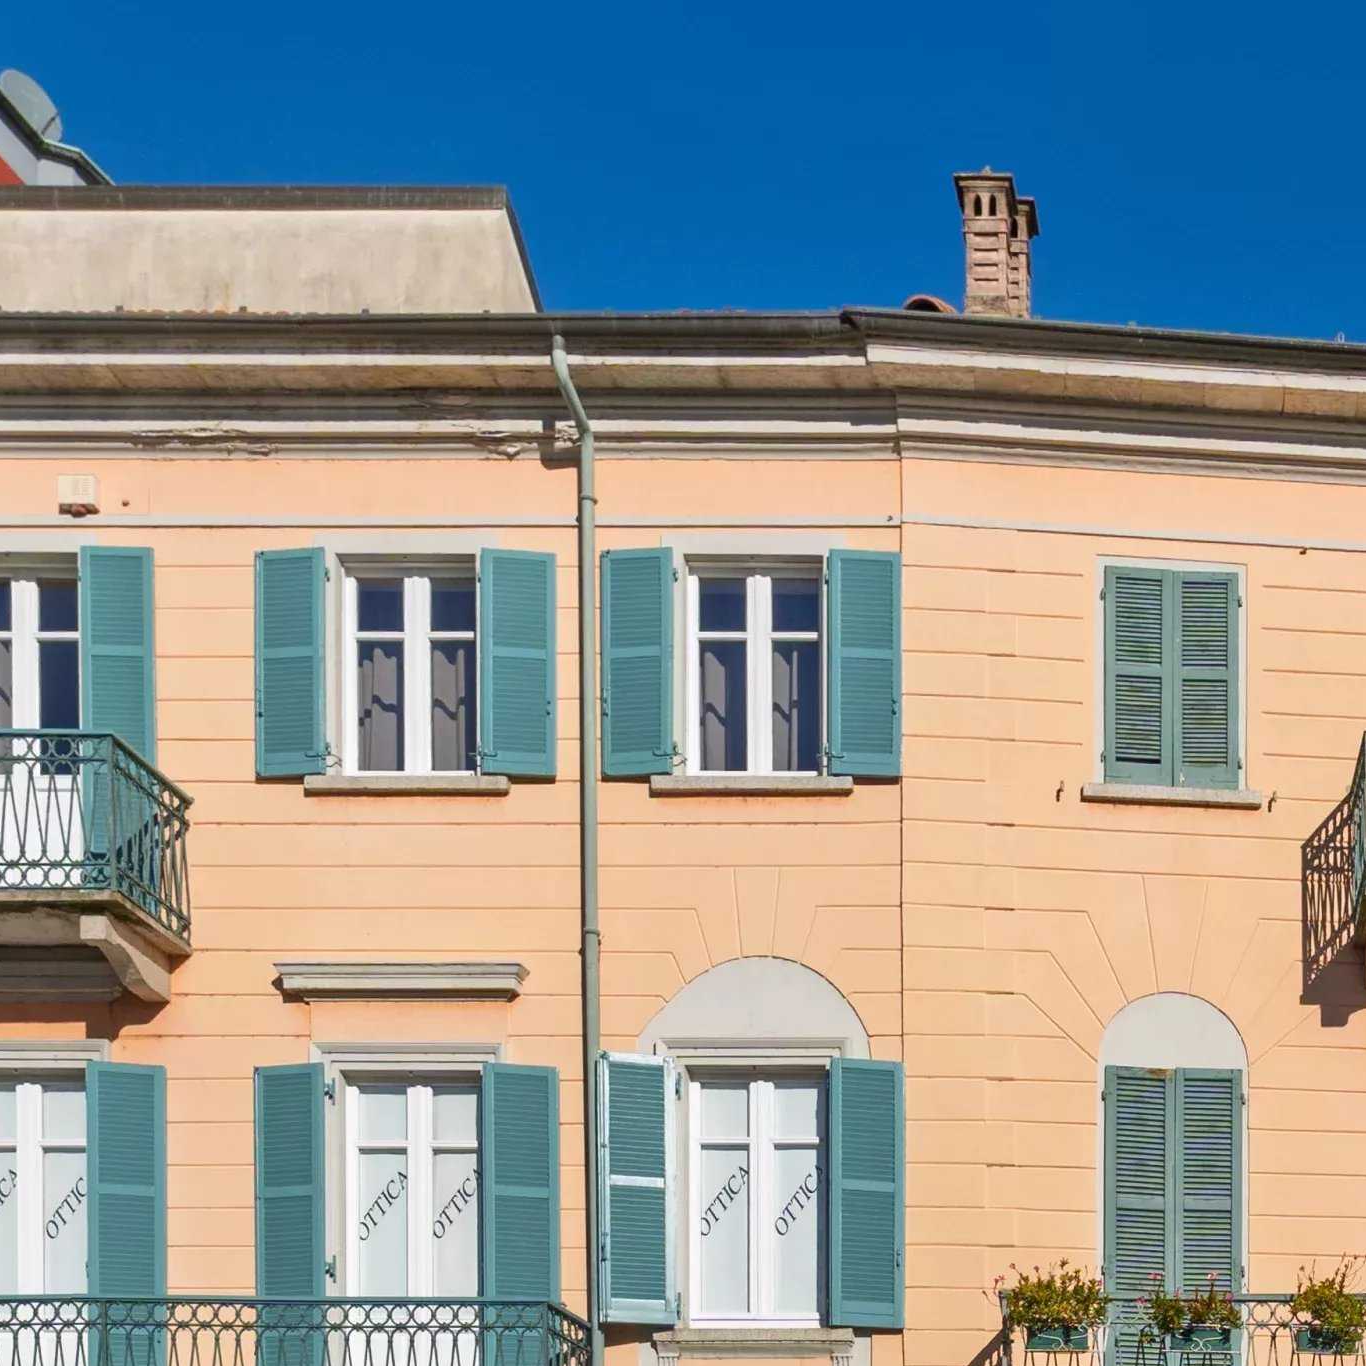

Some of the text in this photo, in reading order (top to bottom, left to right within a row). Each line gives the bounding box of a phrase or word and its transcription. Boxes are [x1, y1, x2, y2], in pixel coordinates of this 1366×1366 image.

[358, 1171, 408, 1241] OTTICA
[700, 1165, 749, 1237] OTTICA
[774, 1164, 824, 1237] OTTICA
